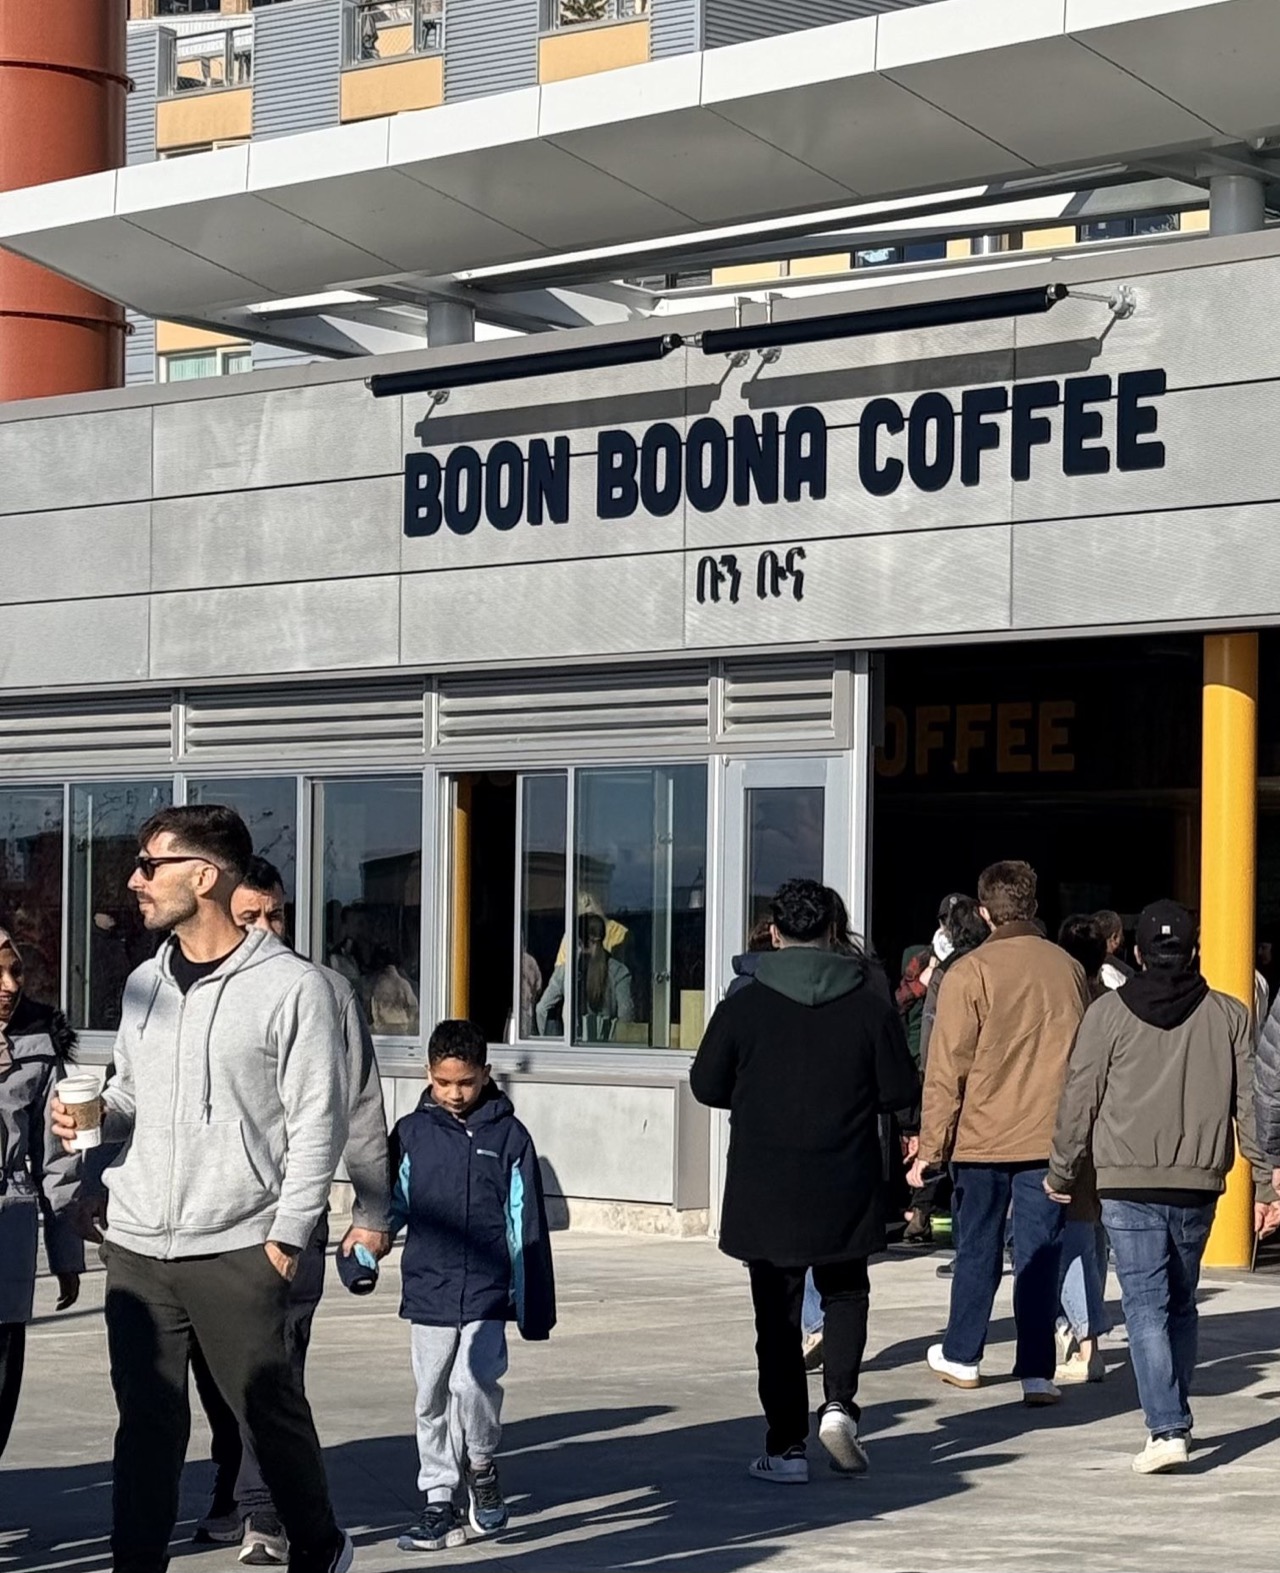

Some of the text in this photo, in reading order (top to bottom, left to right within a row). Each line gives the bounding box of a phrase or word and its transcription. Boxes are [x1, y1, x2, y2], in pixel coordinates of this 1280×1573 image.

[404, 368, 1167, 538] BOON BOONA COFFEE
